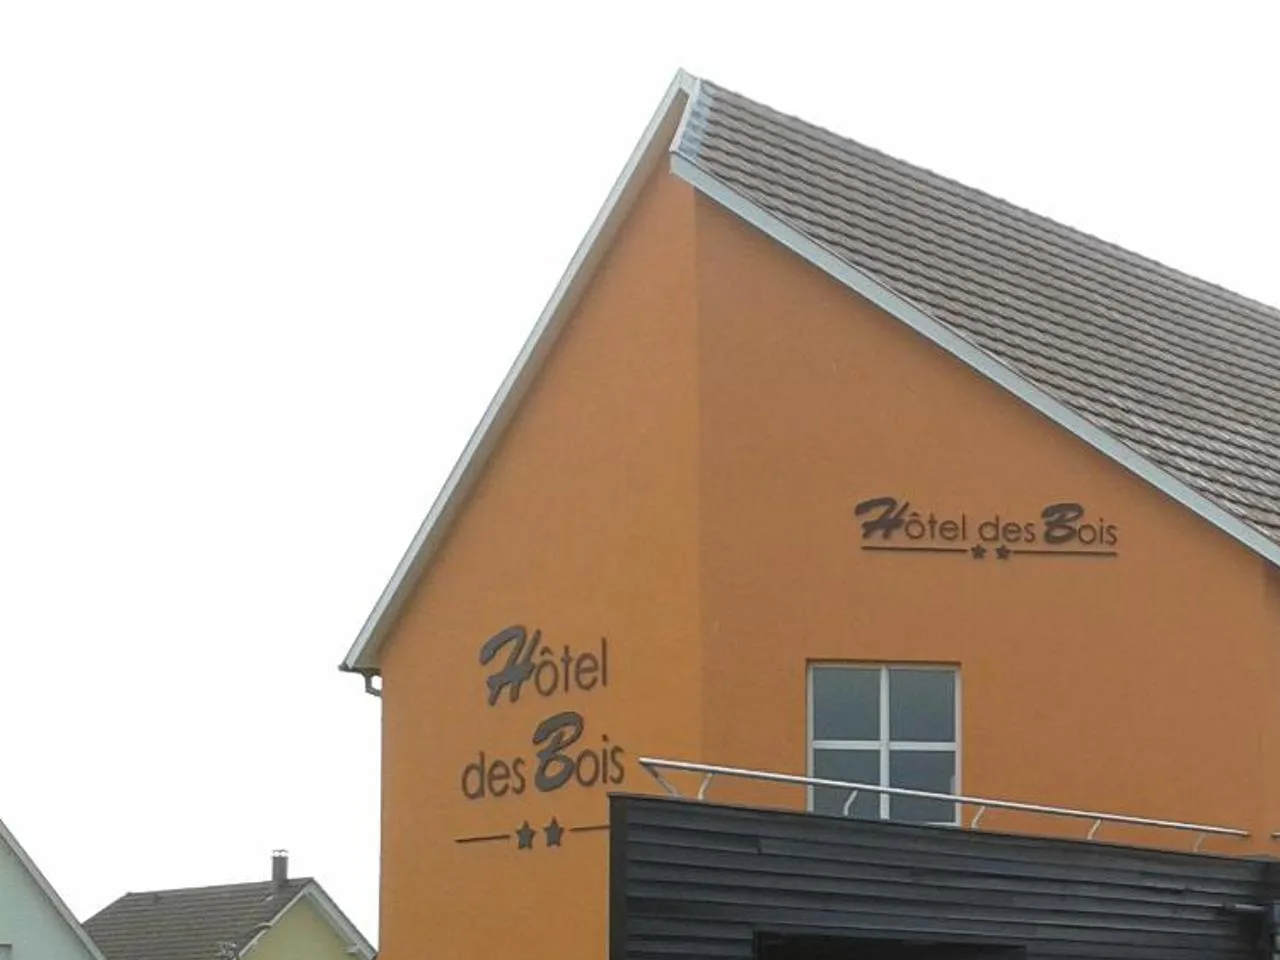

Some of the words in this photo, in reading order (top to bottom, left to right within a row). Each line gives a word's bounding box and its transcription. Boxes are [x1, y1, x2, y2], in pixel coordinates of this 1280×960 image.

[855, 496, 968, 540] Hôtel
[977, 514, 1035, 543] des
[1041, 502, 1119, 546] Bois
[479, 625, 608, 707] Hôtel
[461, 751, 526, 800] des
[532, 711, 625, 792] Bois
